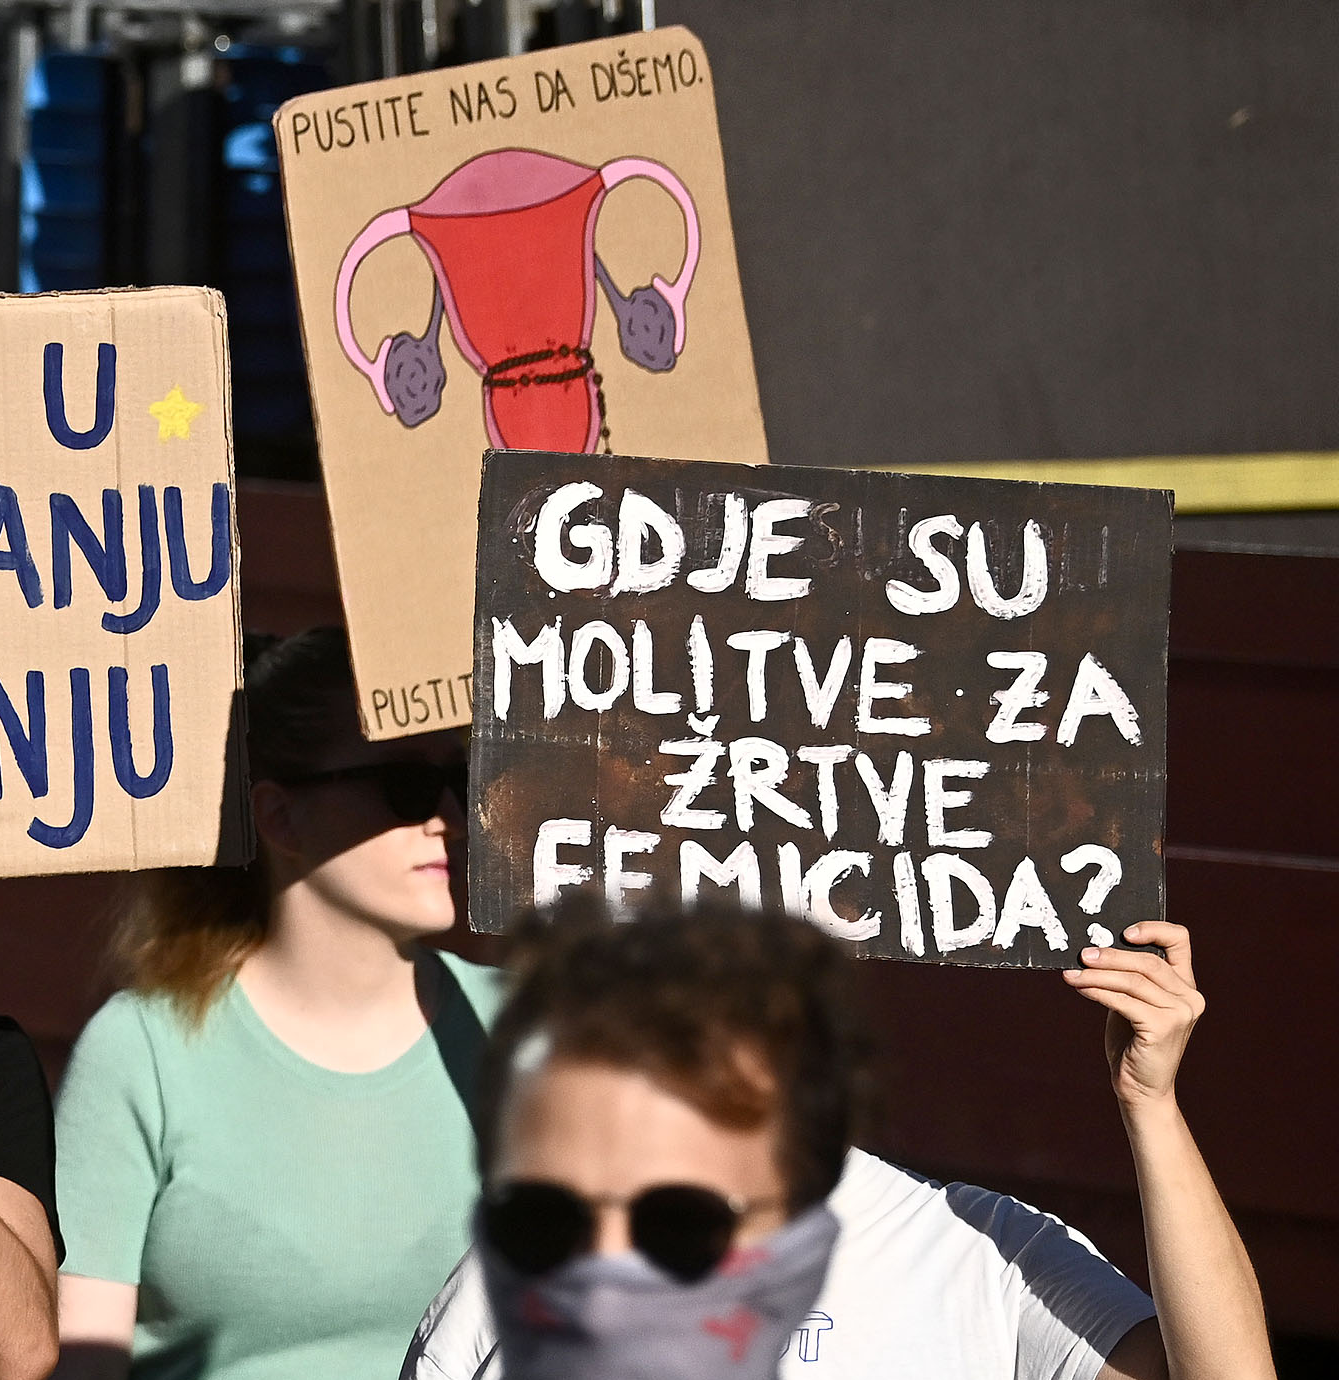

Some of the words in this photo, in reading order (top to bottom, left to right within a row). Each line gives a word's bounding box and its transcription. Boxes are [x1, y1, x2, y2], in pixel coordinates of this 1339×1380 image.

[292, 91, 430, 154] PUSTITE
[449, 75, 517, 127] NAS
[534, 69, 575, 114] DA
[590, 48, 704, 102] DIŠEMO.
[42, 341, 117, 450] U
[531, 480, 813, 602] GDJE
[885, 514, 1049, 621] SU
[491, 614, 932, 738] MOLITVE
[985, 651, 1146, 747] ZA
[658, 712, 996, 850] ŽRTVE
[531, 818, 1123, 957] FEMICIDA?
